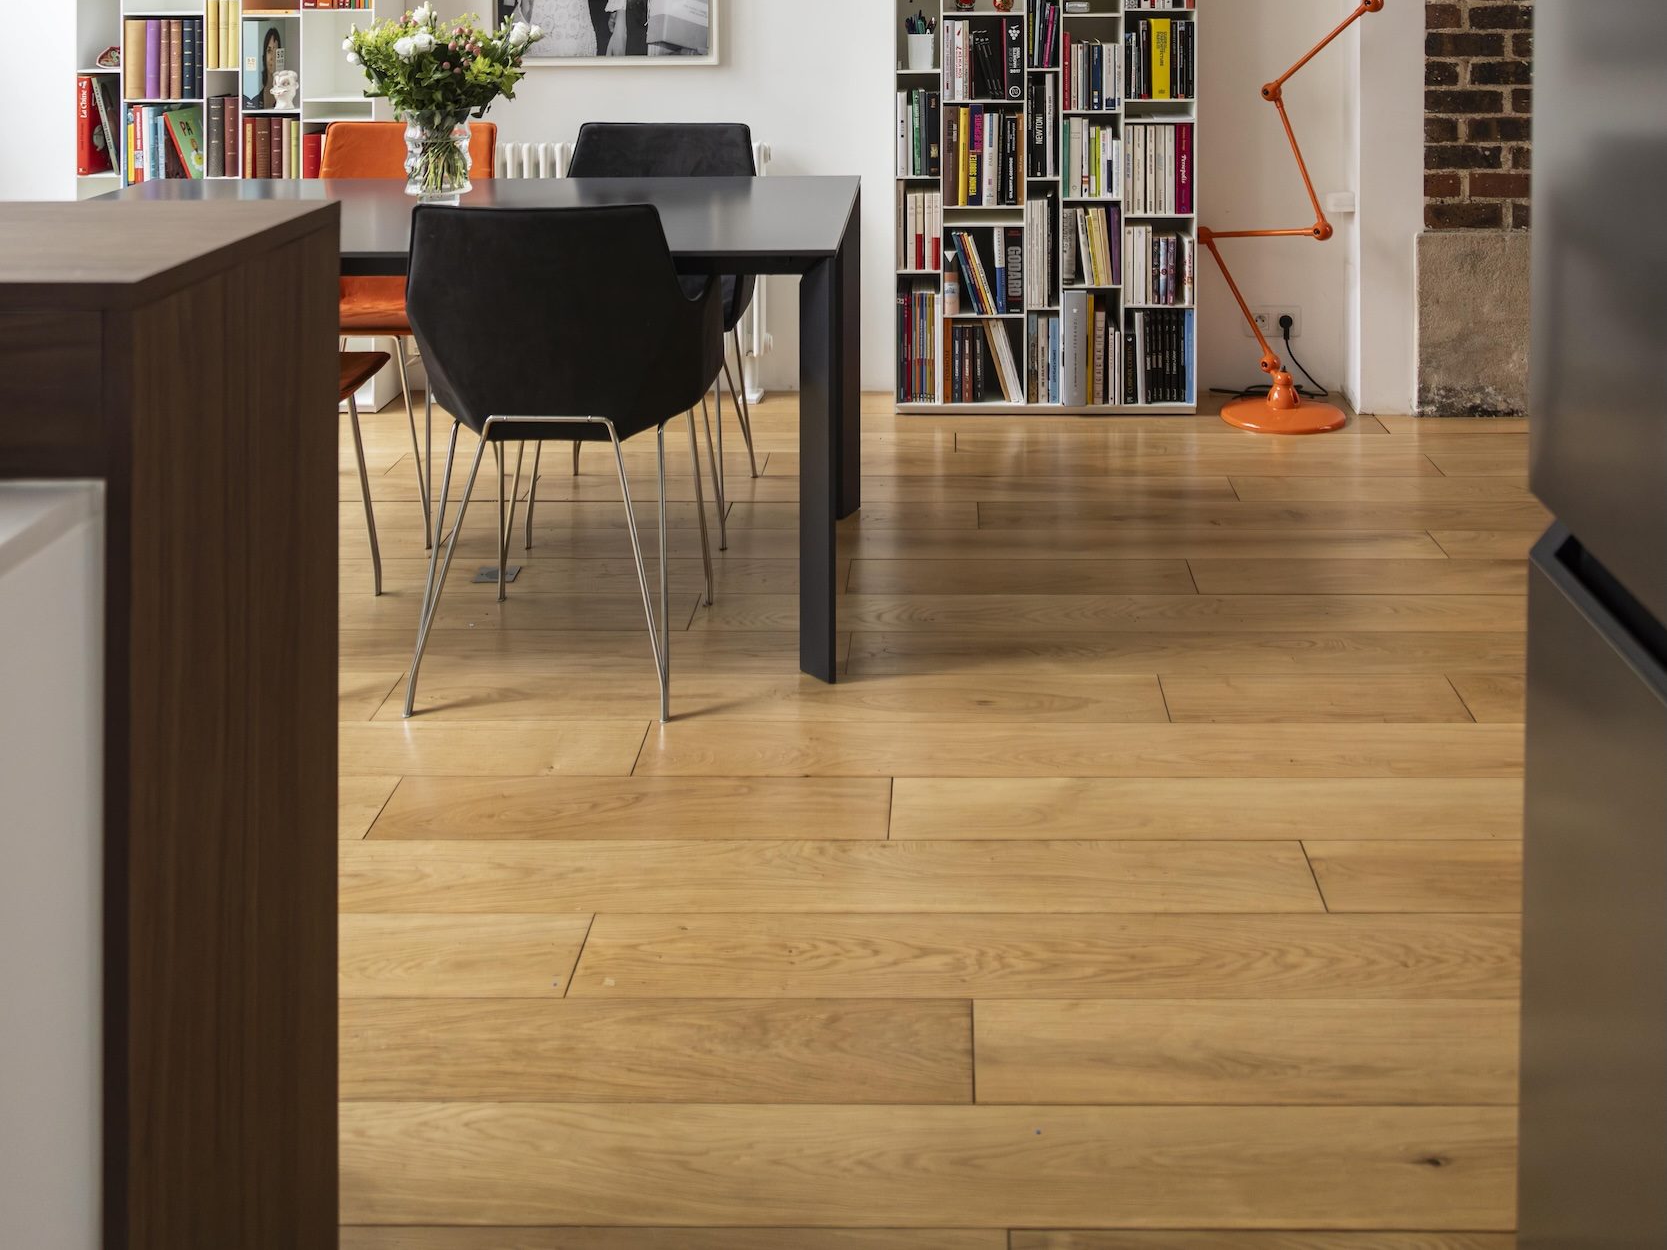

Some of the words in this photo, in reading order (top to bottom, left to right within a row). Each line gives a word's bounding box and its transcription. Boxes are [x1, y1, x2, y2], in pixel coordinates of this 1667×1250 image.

[80, 90, 88, 109] Chine
[80, 110, 88, 118] La
[1035, 117, 1043, 145] NEWTON
[1007, 246, 1022, 297] GODARD
